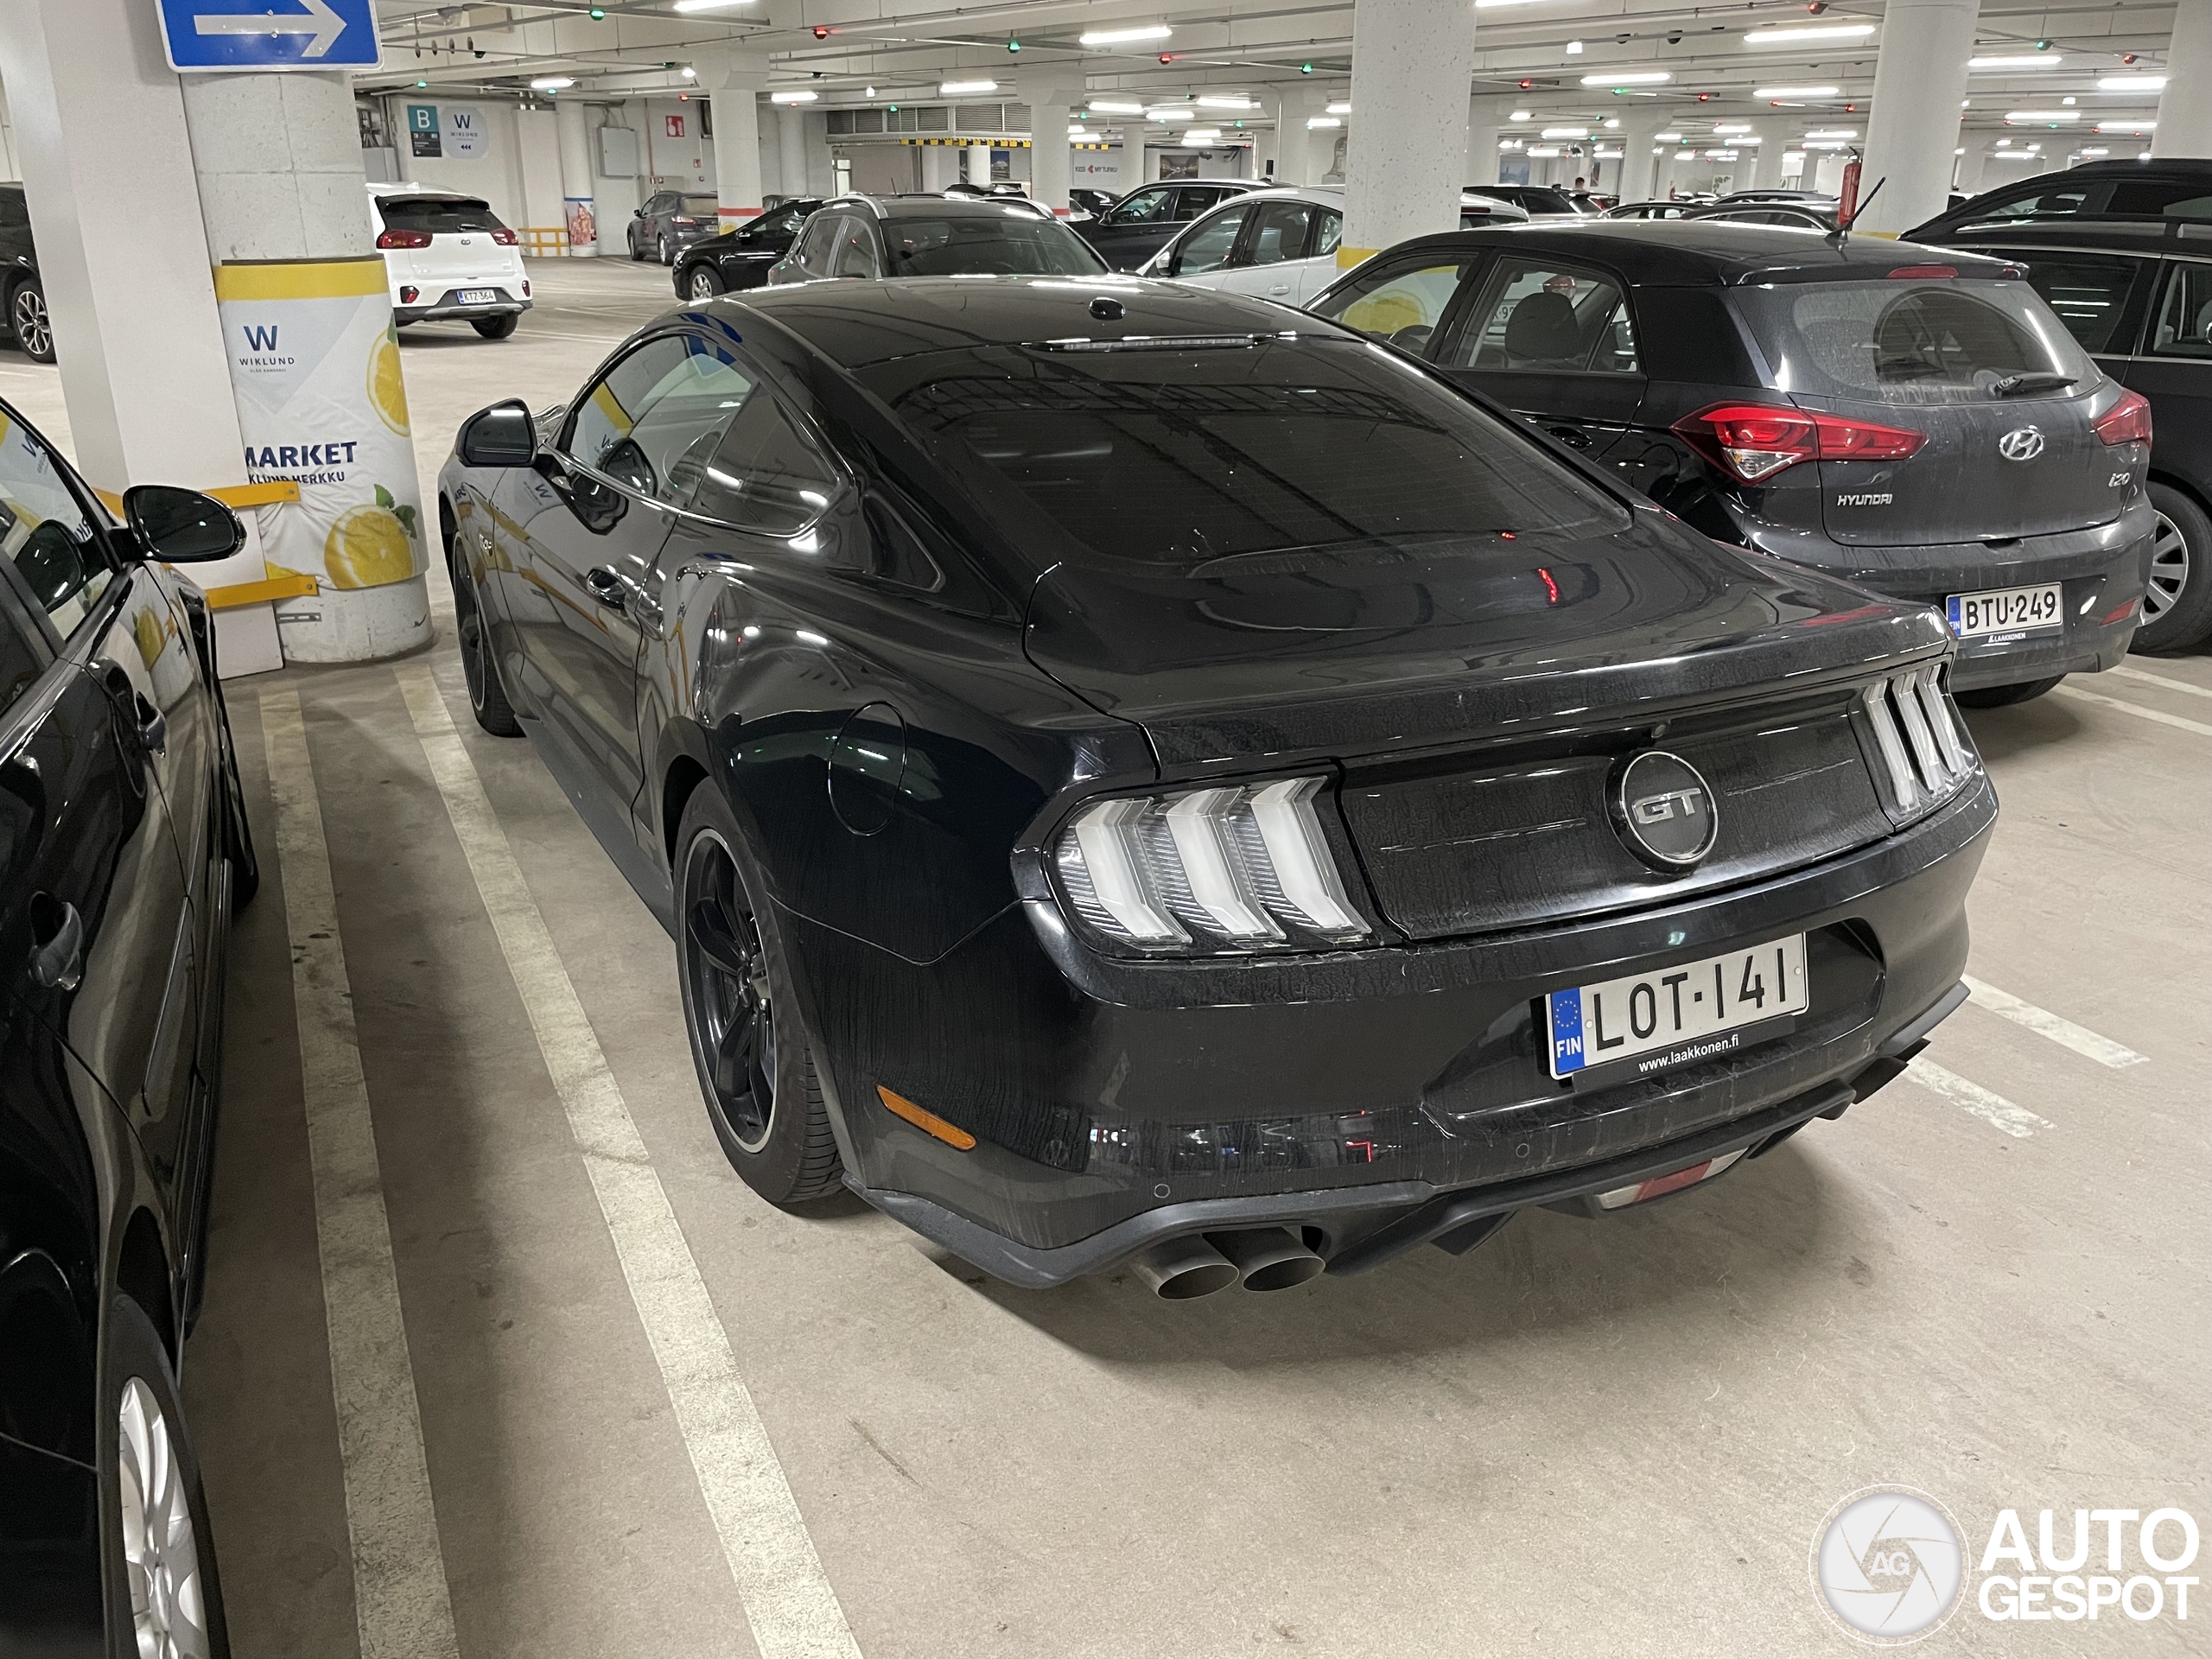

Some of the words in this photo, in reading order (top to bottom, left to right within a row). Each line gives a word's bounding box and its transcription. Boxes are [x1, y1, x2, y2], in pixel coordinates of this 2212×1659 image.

[416, 110, 430, 128] B
[454, 114, 470, 129] W
[464, 291, 493, 301] KTZ-364
[243, 325, 277, 352] W
[239, 357, 295, 365] WIKLUND
[245, 441, 357, 467] MARKET
[1837, 493, 1893, 506] HYUNDAI
[1966, 590, 2056, 630] BTU-249
[1632, 787, 1701, 823] GT
[1593, 947, 1786, 1052] LOT-141
[1556, 1035, 1582, 1059] FIN
[1638, 1034, 1739, 1073] www.laakkonen.fi
